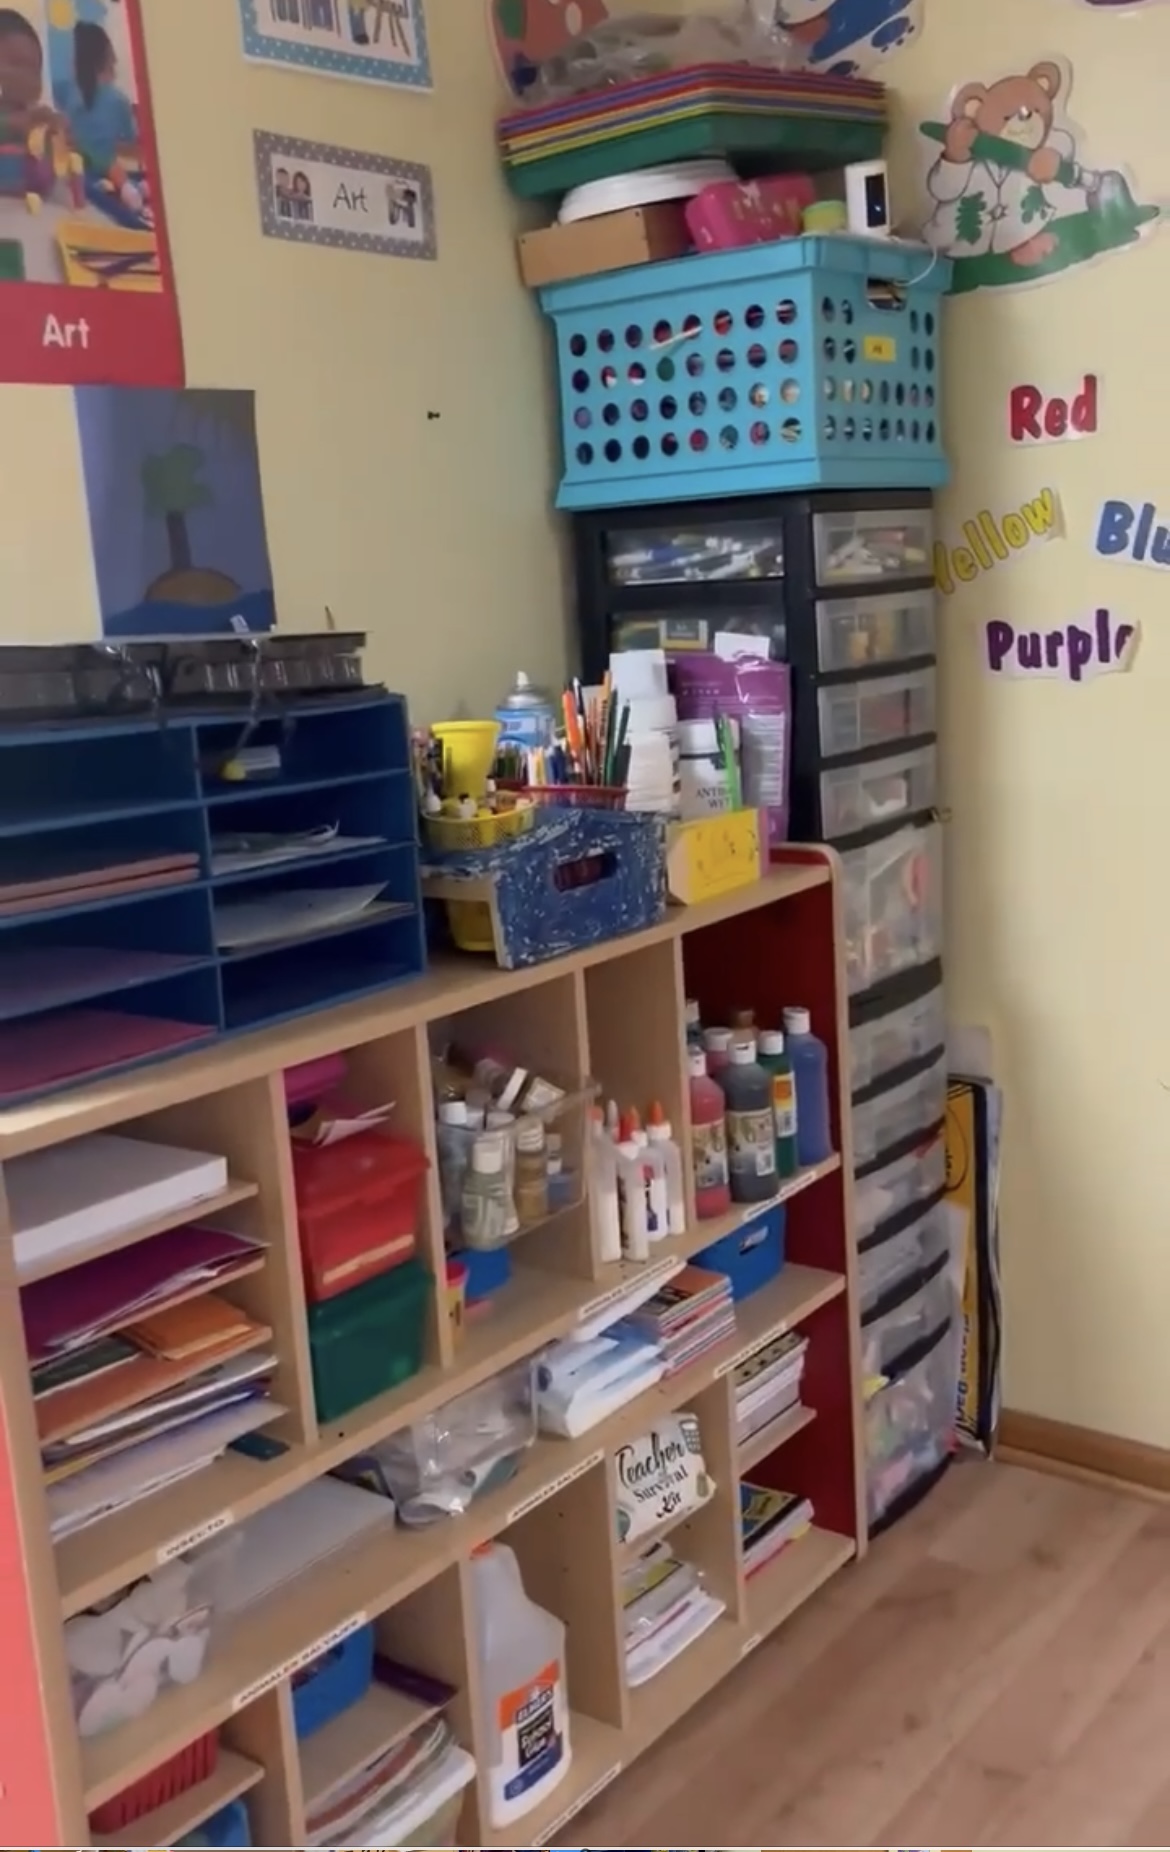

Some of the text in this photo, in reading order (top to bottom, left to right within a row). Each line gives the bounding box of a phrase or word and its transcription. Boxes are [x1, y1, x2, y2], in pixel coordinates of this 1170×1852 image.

[332, 182, 368, 213] Art
[42, 313, 90, 349] Art
[1010, 373, 1098, 441] Red
[614, 1431, 686, 1489] Teacher
[632, 1464, 689, 1504] Survival
[240, 1661, 299, 1703] ANIMALES
